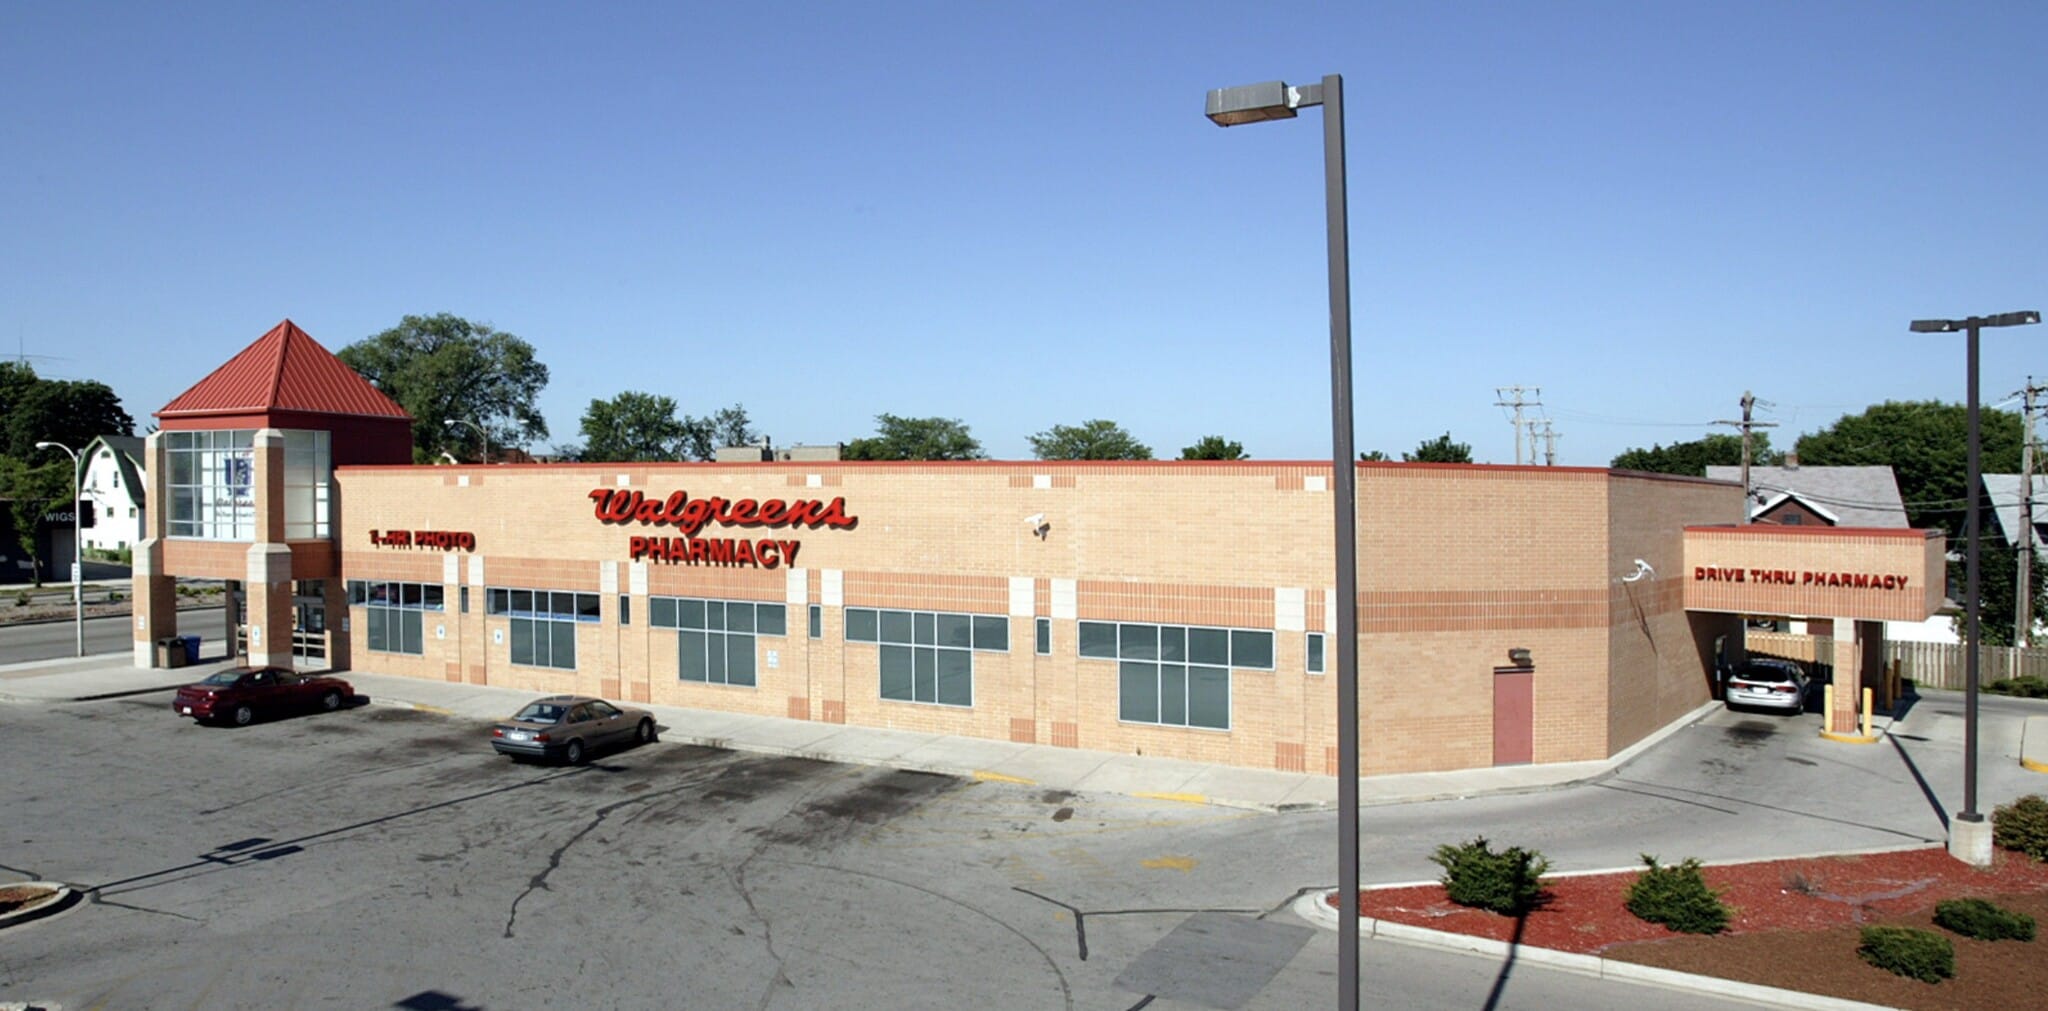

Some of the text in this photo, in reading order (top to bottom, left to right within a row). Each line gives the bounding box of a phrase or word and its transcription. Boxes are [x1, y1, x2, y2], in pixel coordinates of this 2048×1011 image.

[45, 512, 75, 522] WIGS
[588, 489, 858, 534] Walgreens
[368, 529, 475, 551] 1-HR PHOTO
[629, 536, 800, 568] PHARMACY
[1694, 566, 1908, 590] DRIVE THRU PHARMACY
